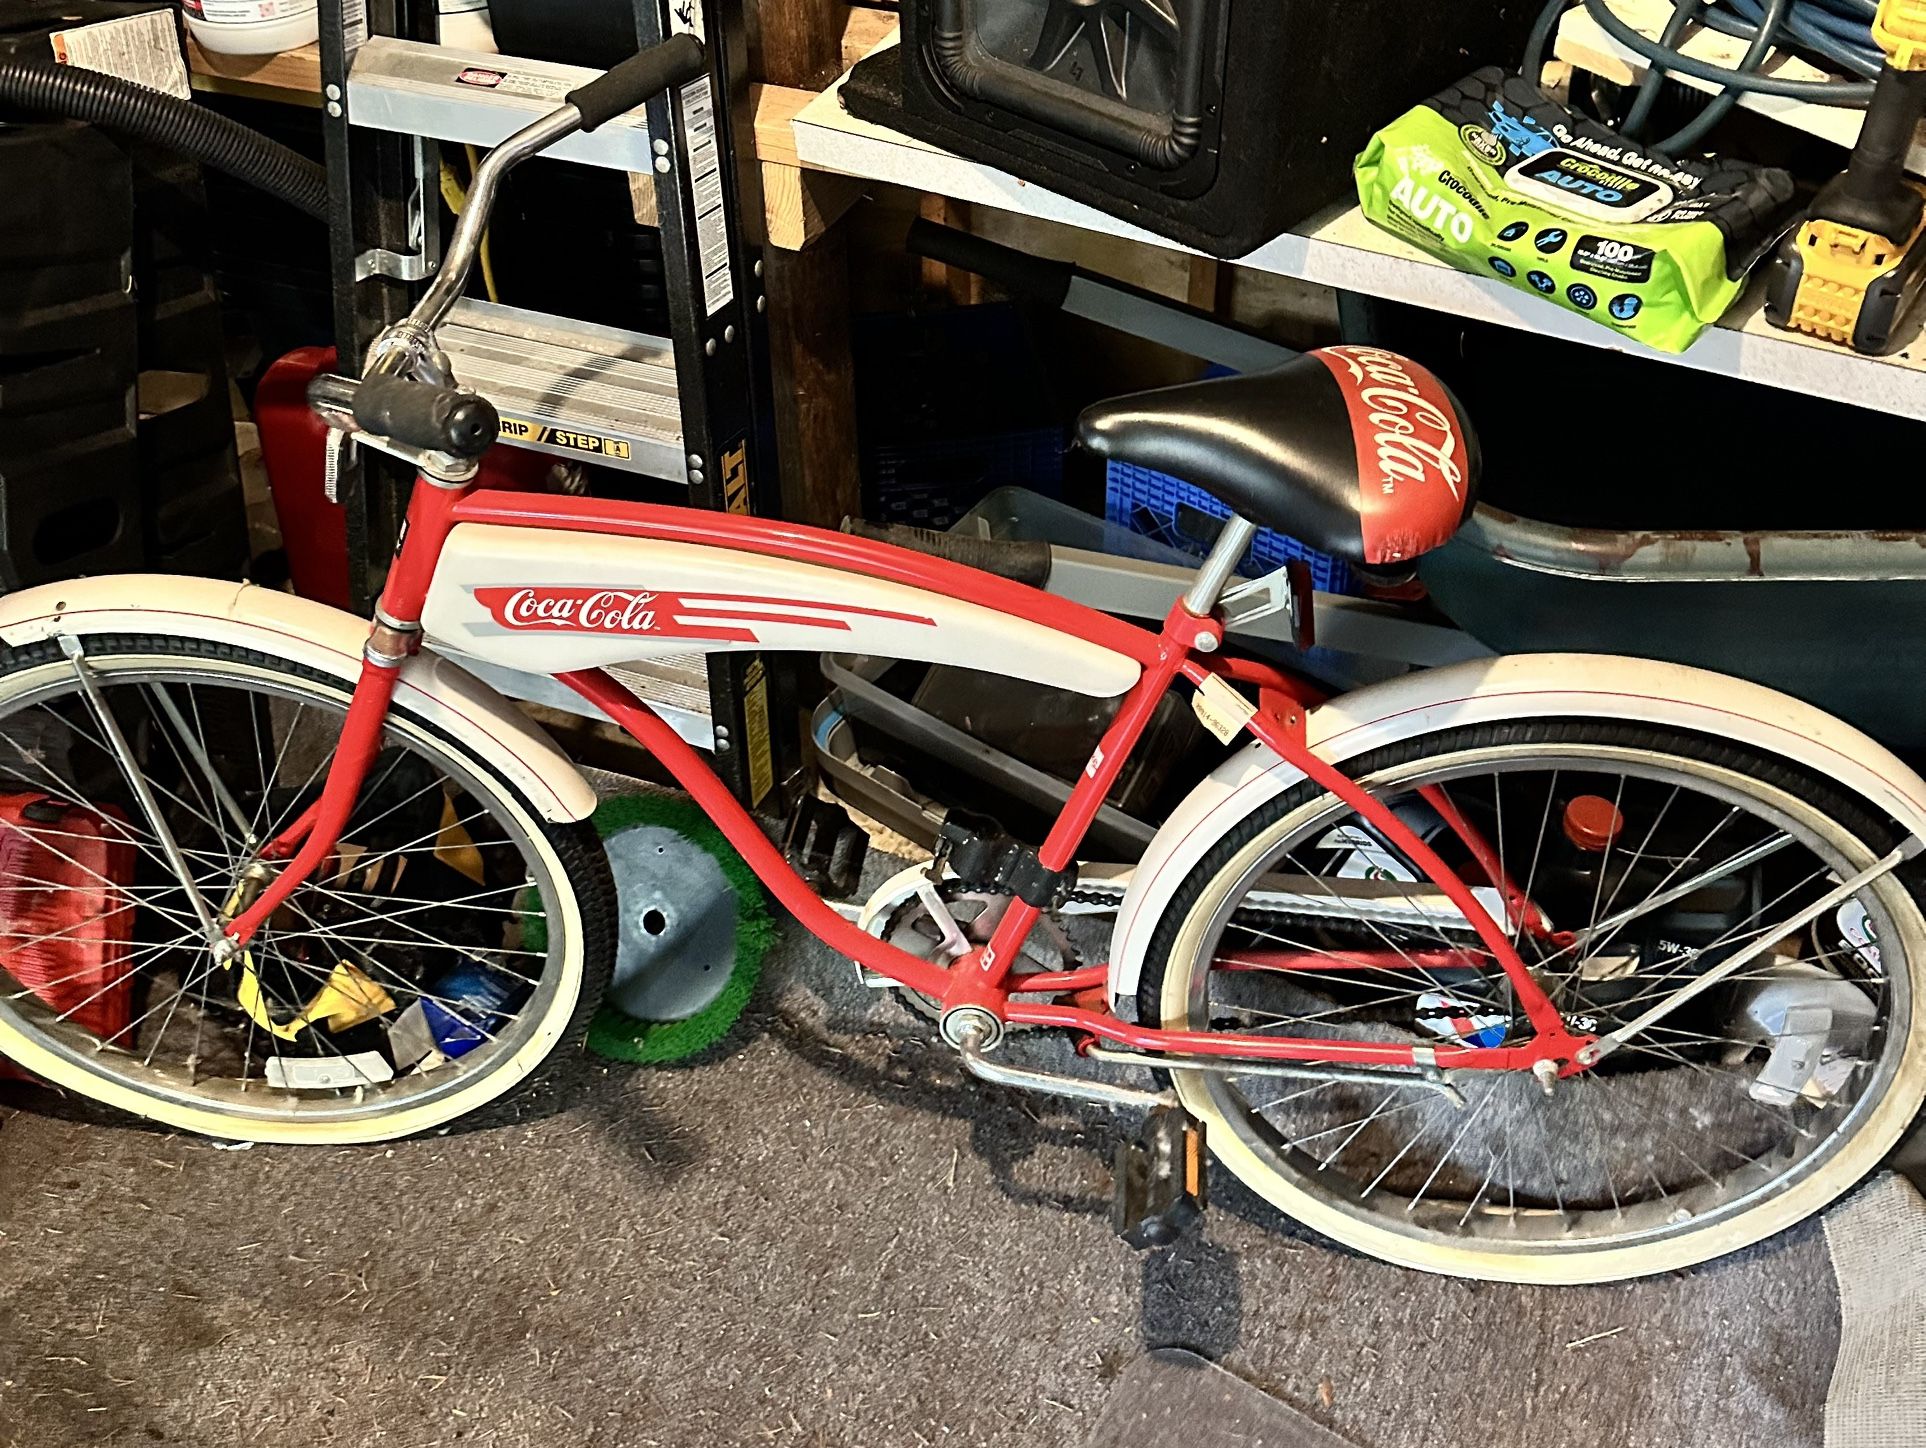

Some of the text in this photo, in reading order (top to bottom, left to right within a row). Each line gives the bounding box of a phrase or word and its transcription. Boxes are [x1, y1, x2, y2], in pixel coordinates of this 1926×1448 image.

[1534, 169, 1623, 202] AUTO
[1388, 175, 1474, 244] AUTO
[1596, 240, 1634, 262] 100
[499, 420, 601, 451] RIP STEP
